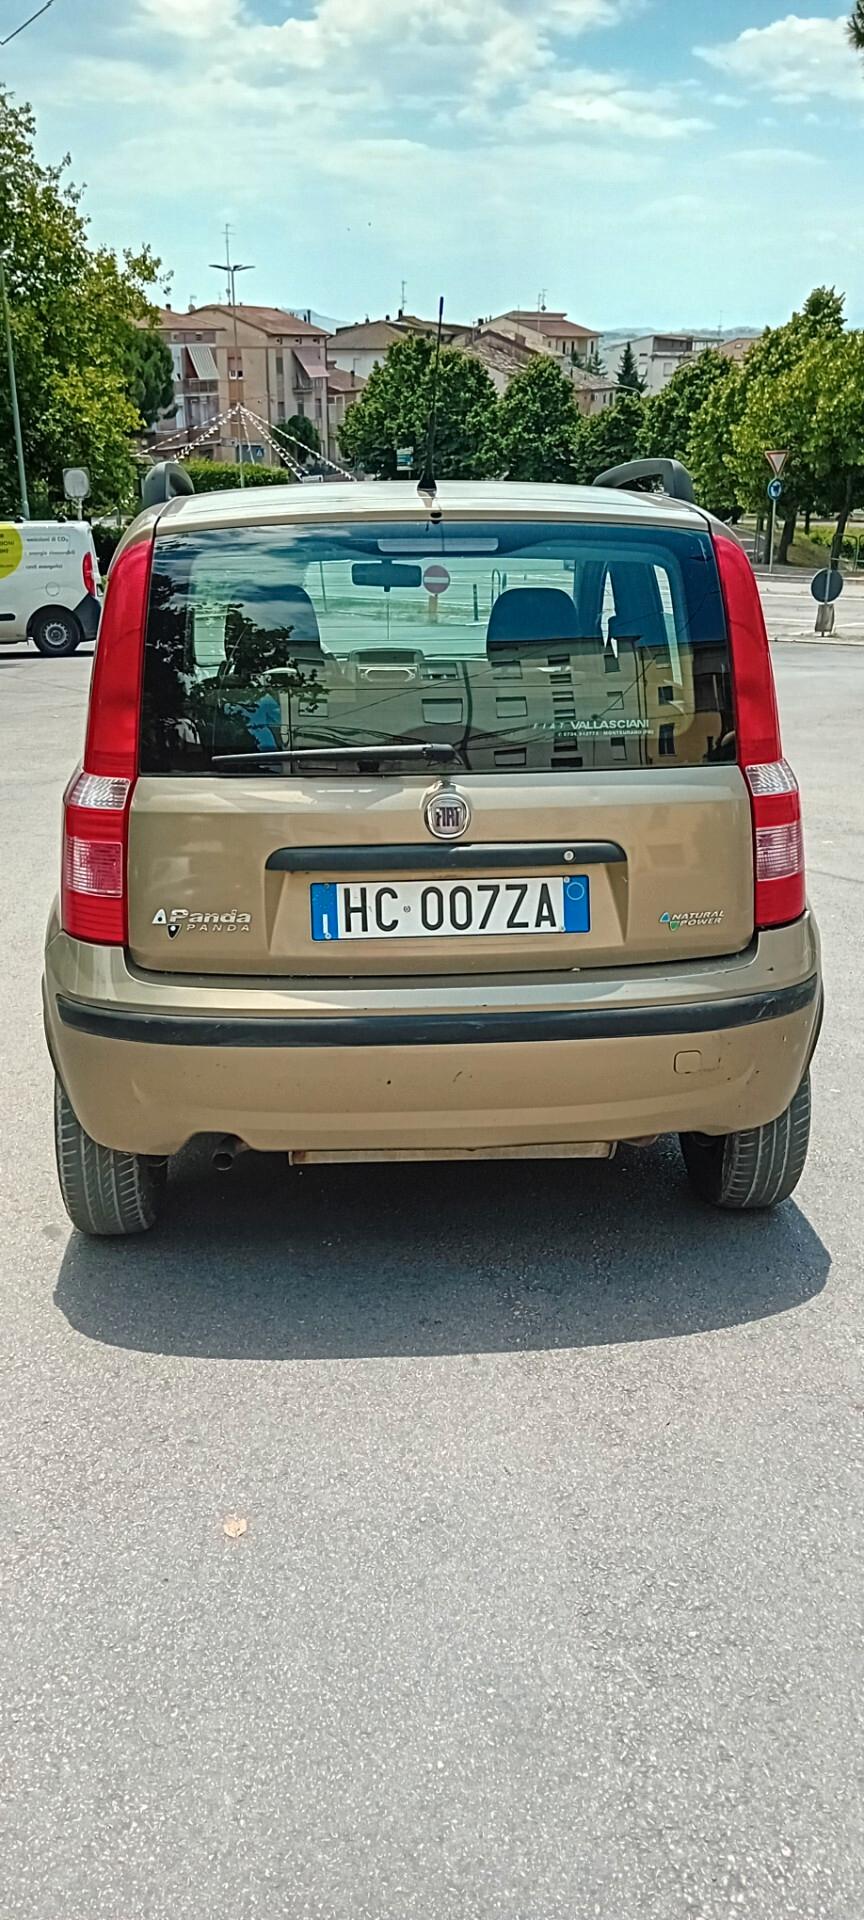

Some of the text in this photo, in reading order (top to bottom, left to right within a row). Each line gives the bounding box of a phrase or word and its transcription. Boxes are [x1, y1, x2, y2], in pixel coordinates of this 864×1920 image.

[570, 719, 649, 730] VALLASCIANI
[436, 807, 460, 827] FIAT
[343, 882, 558, 933] HC 007ZA
[169, 908, 252, 923] Panda
[671, 910, 725, 921] NATURAL
[186, 923, 251, 932] PANDA
[680, 918, 721, 926] POWER
